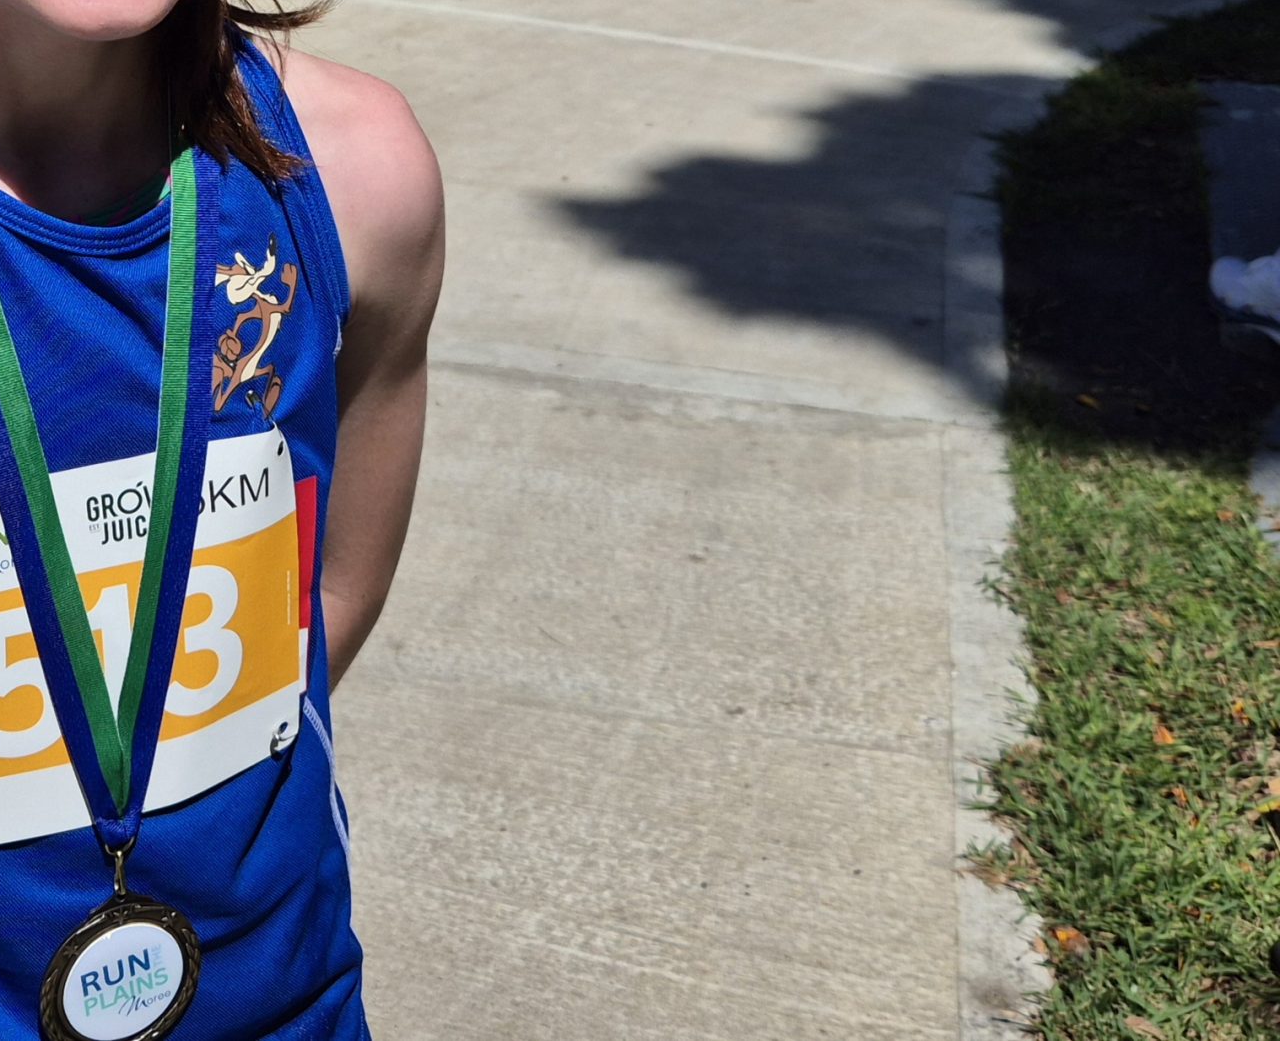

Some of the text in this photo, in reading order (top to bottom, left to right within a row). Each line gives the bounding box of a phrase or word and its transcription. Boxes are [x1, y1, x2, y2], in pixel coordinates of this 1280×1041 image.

[86, 480, 151, 522] GRÓ
[101, 515, 148, 546] JUIC
[80, 943, 162, 997] RUN THE
[83, 967, 169, 1018] PLAINS
[118, 990, 172, 1017] Moree
